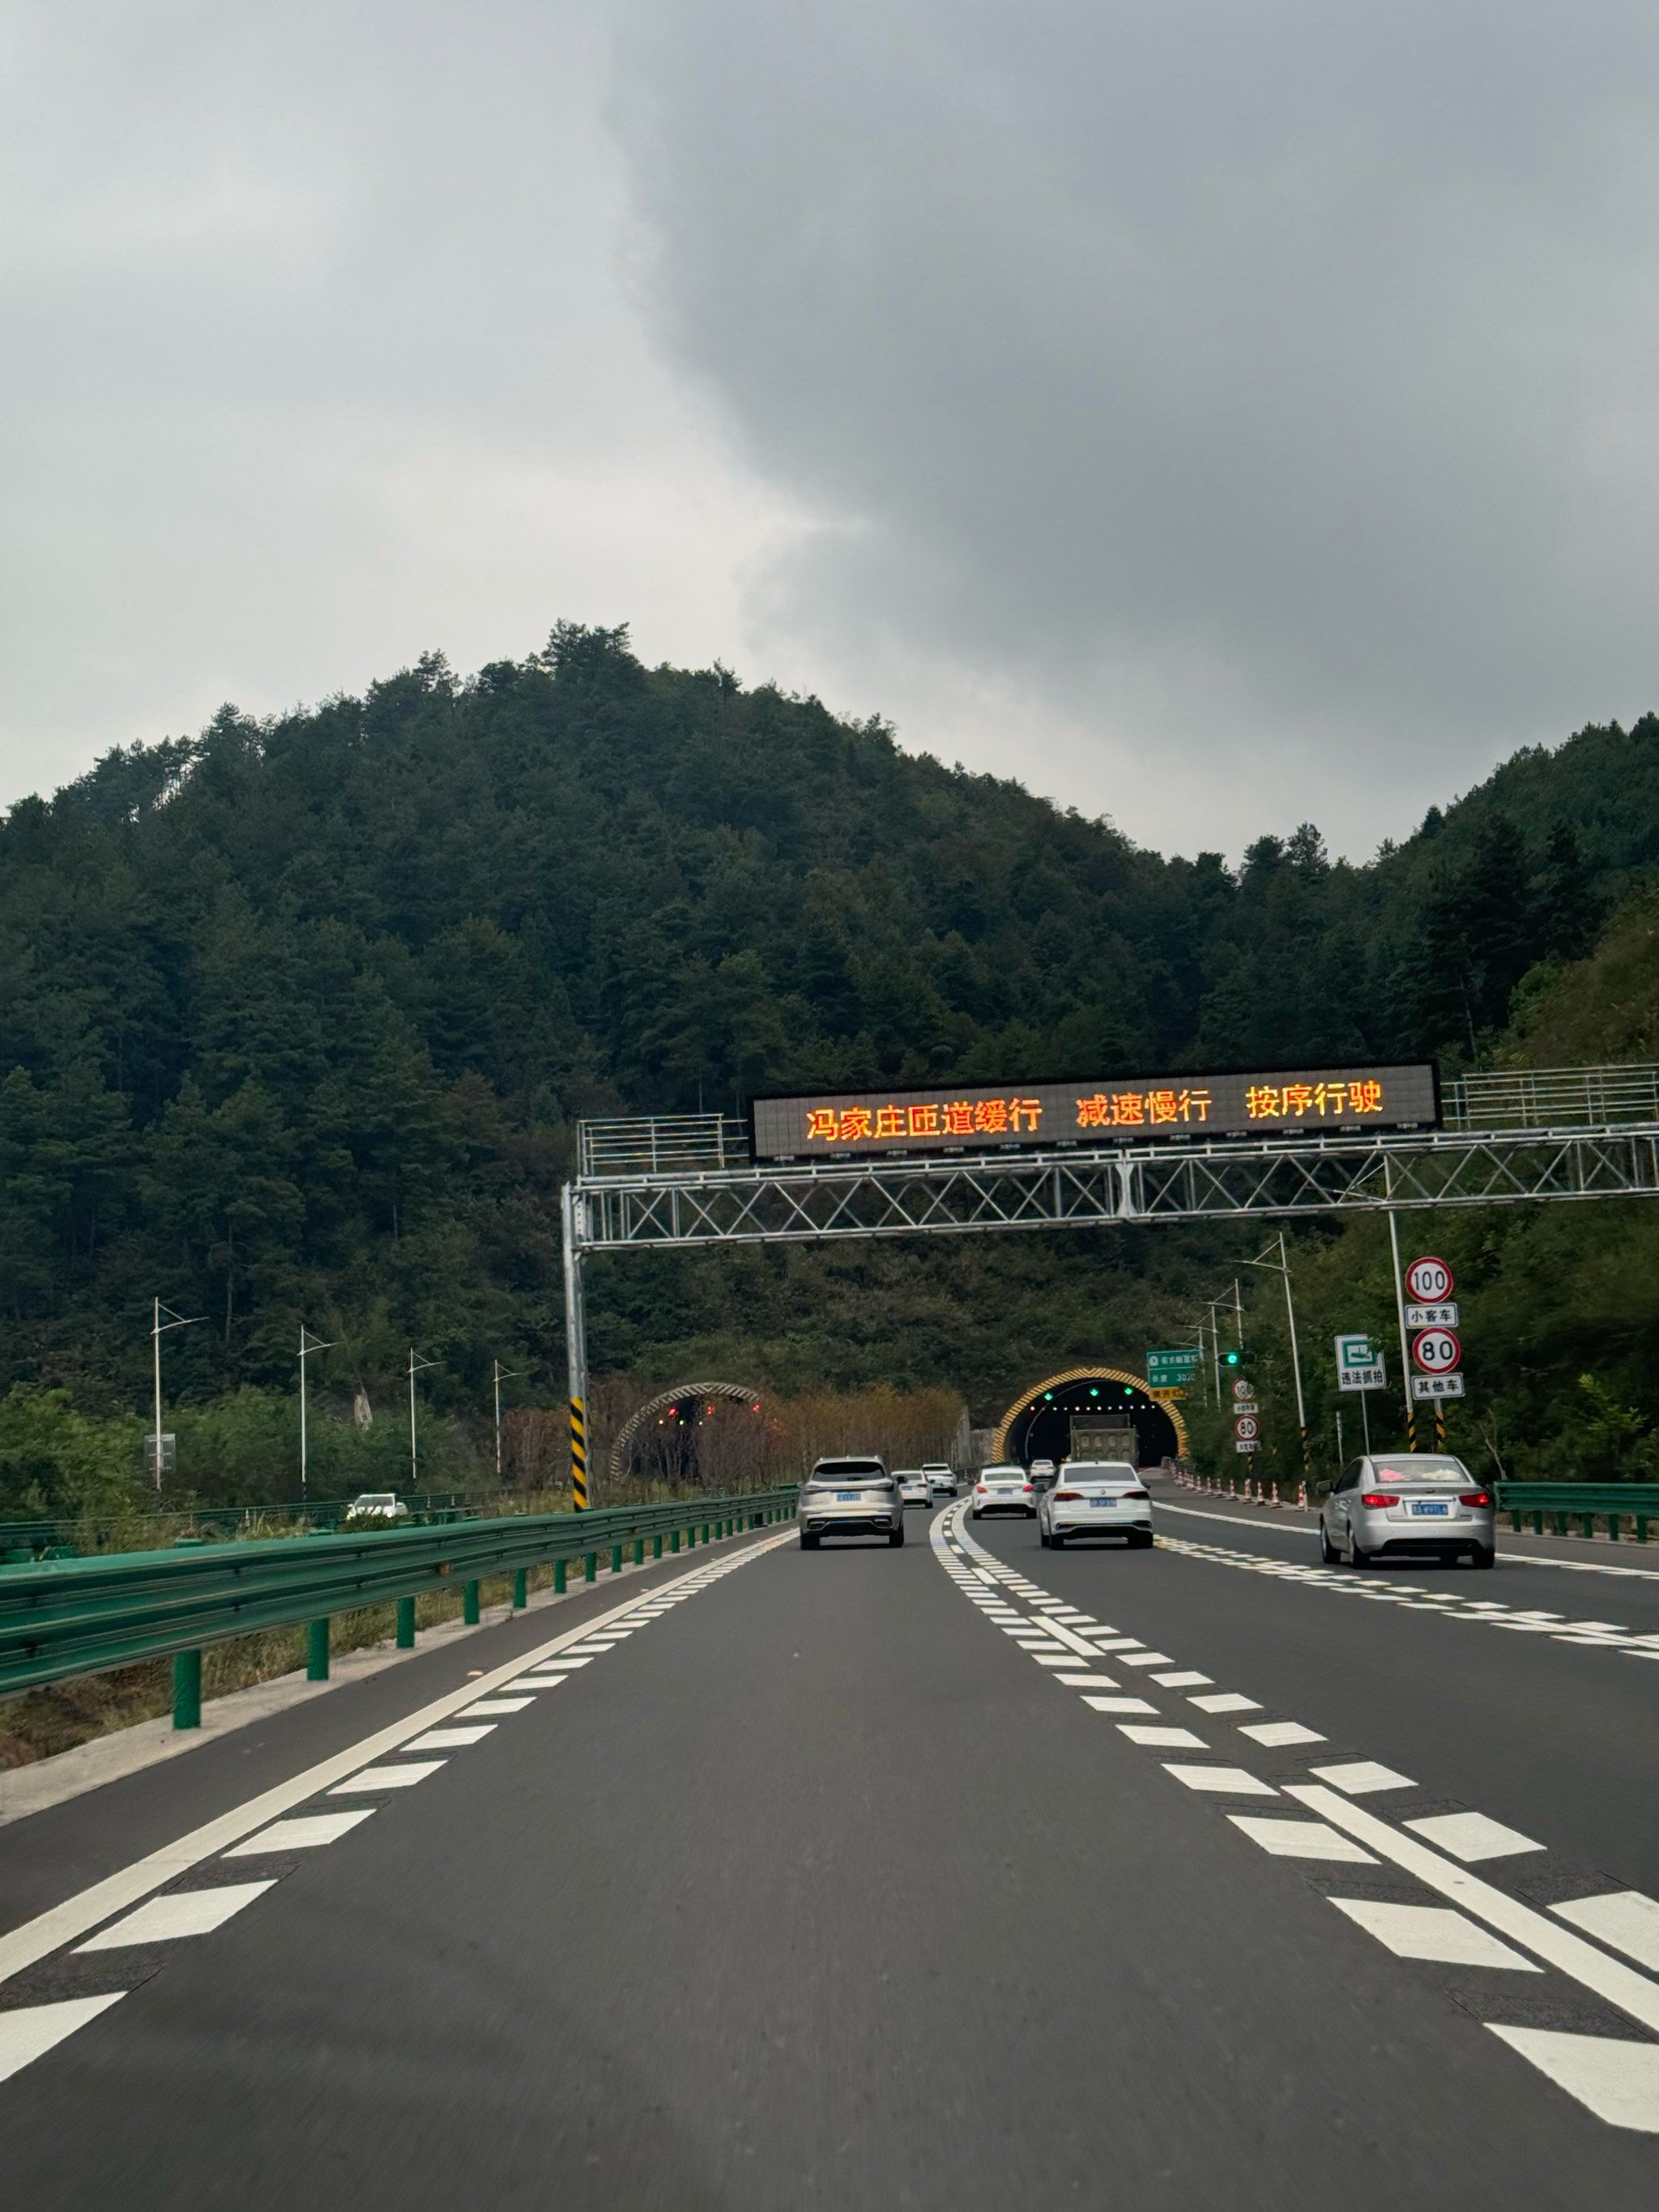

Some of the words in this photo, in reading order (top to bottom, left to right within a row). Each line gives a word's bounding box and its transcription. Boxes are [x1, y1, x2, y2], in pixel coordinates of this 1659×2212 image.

[805, 1097, 1043, 1142] 冯家庄匝道缓行
[1076, 1089, 1212, 1128] 减速慢行
[1245, 1079, 1384, 1119] 按序行驶
[1414, 1271, 1446, 1291] 100
[1411, 1309, 1452, 1323] 小客车
[1422, 1341, 1453, 1361] 80
[1341, 1371, 1383, 1386] 违法抓拍
[1418, 1380, 1459, 1394] 其他车
[1240, 1421, 1254, 1435] 80
